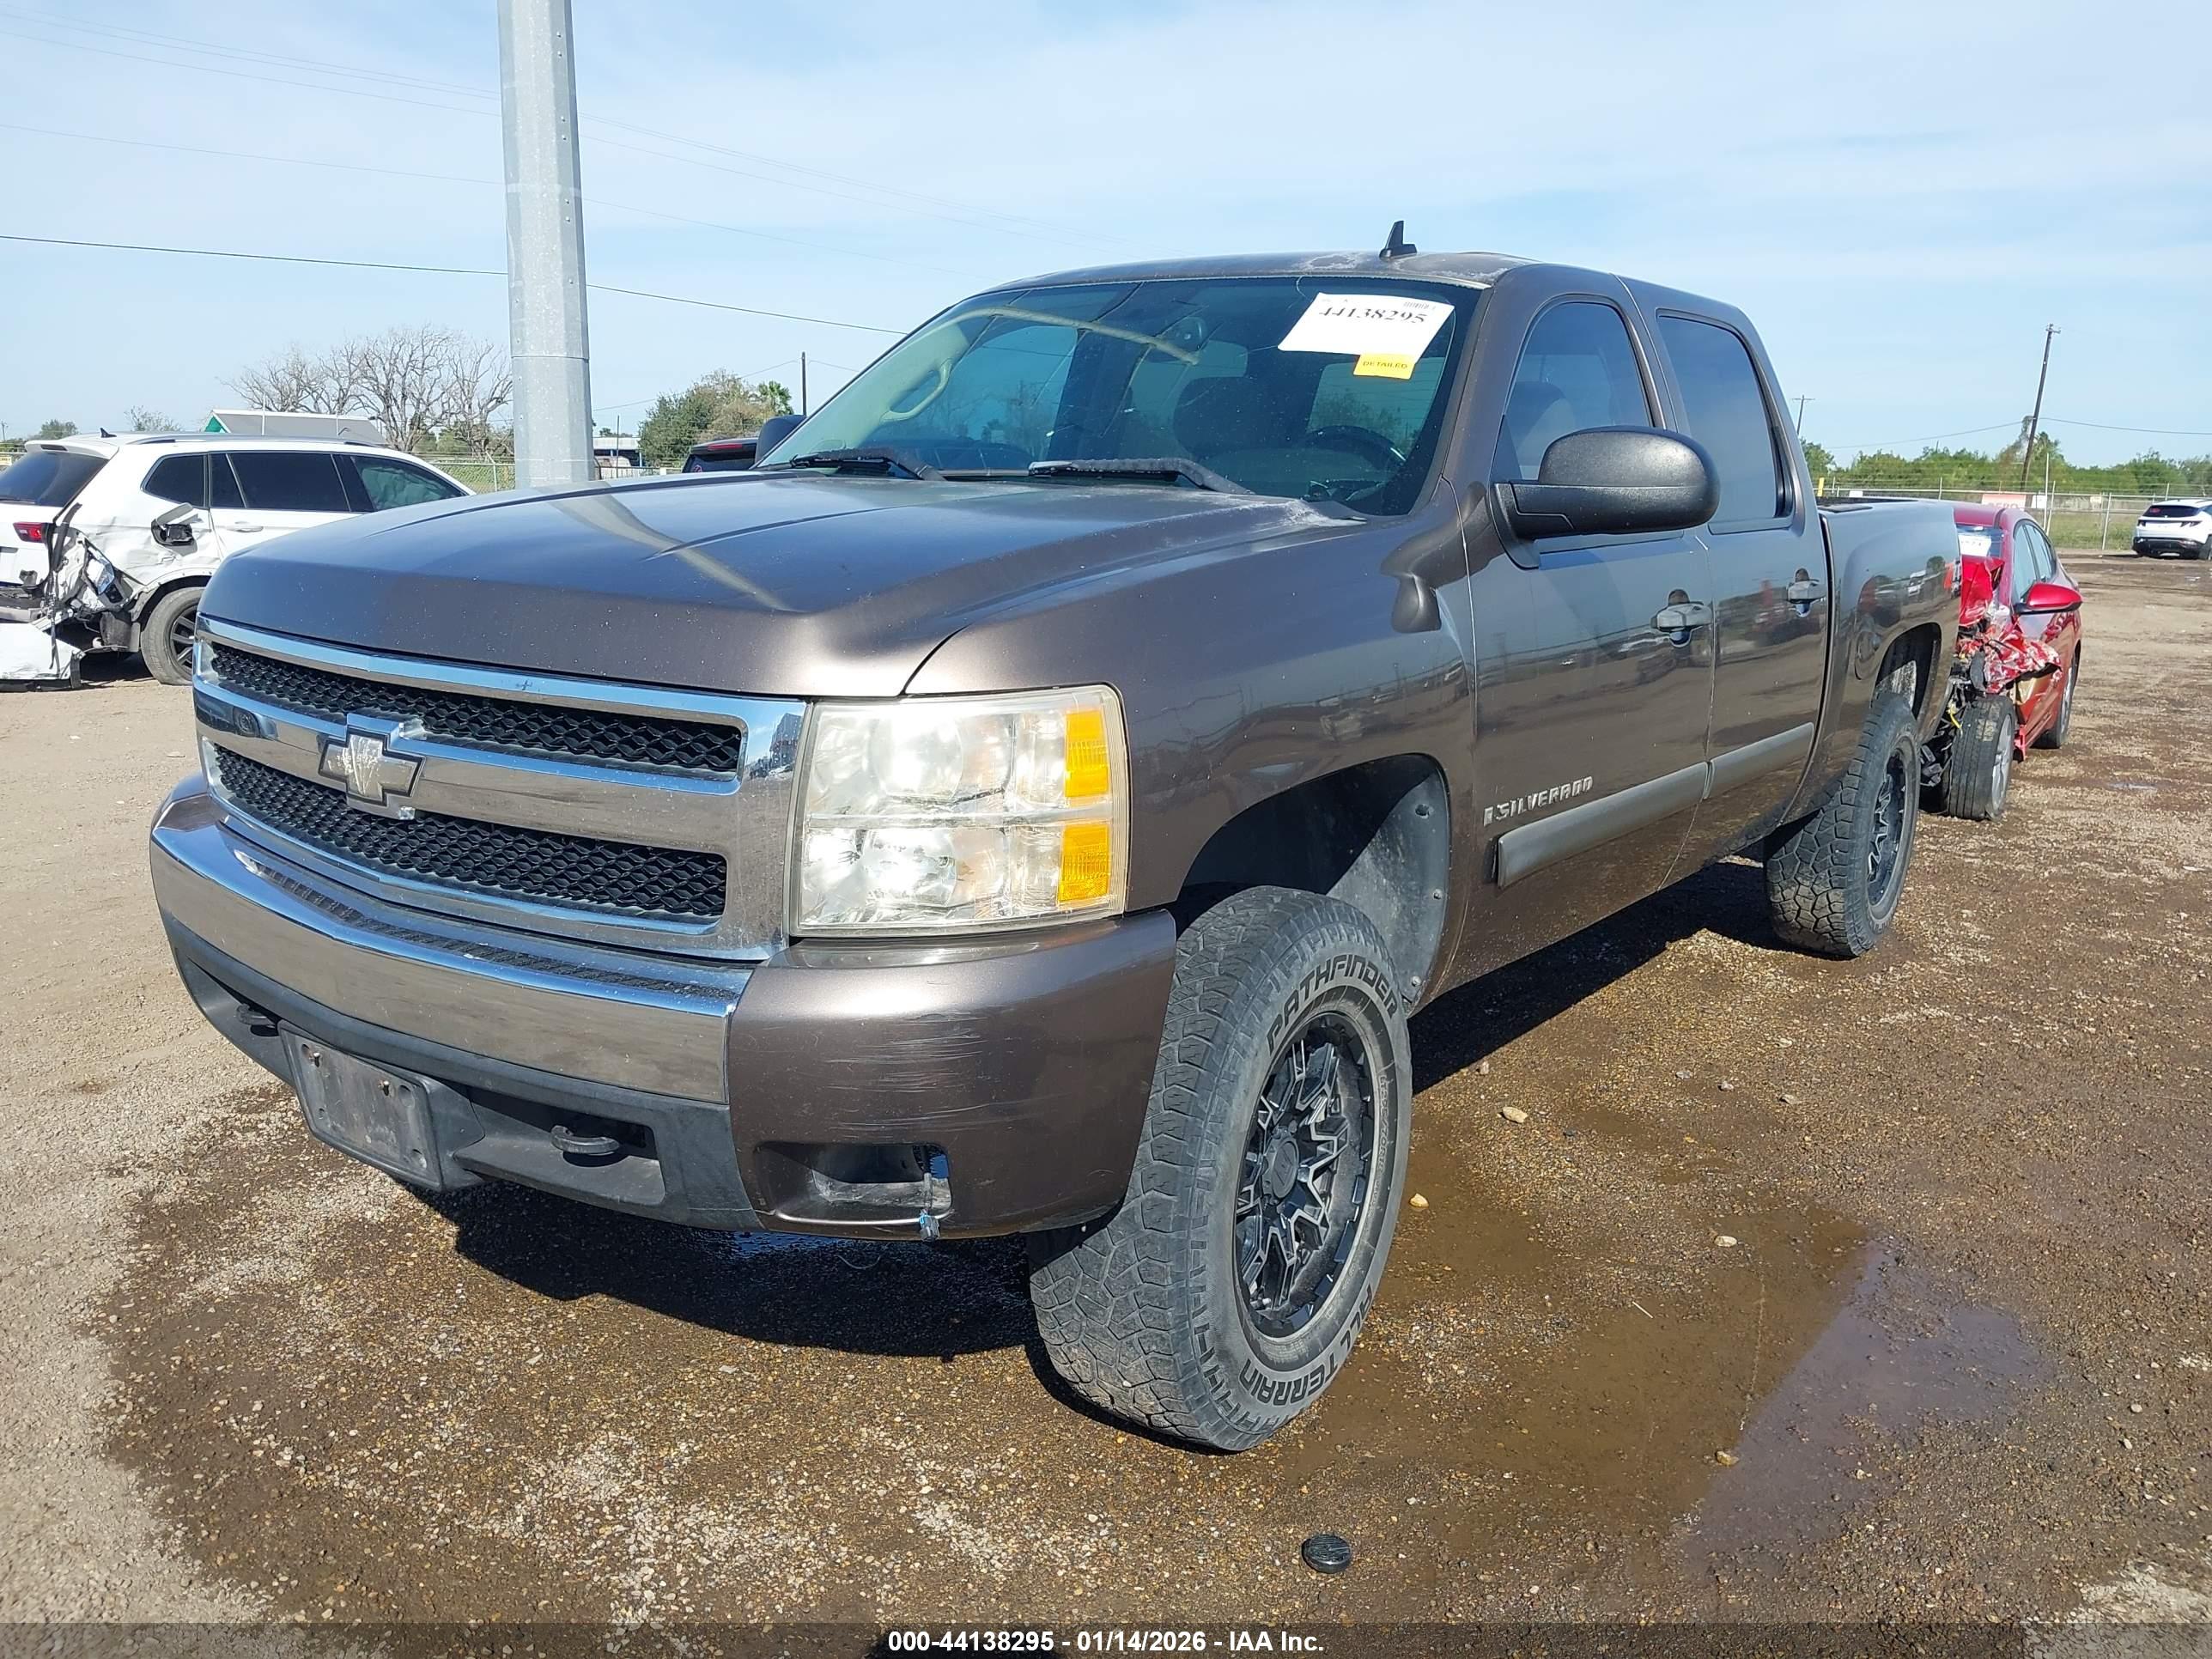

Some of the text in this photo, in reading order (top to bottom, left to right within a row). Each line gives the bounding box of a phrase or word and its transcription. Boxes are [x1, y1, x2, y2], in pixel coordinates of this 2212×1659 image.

[1319, 307, 1428, 323] 44138295
[1363, 361, 1407, 369] DETAILED
[1494, 775, 1594, 821] SILVERADO
[1265, 954, 1398, 1057] PATHFINDER
[1340, 1283, 1373, 1352] ALL
[1238, 1352, 1339, 1407] TERRAIN
